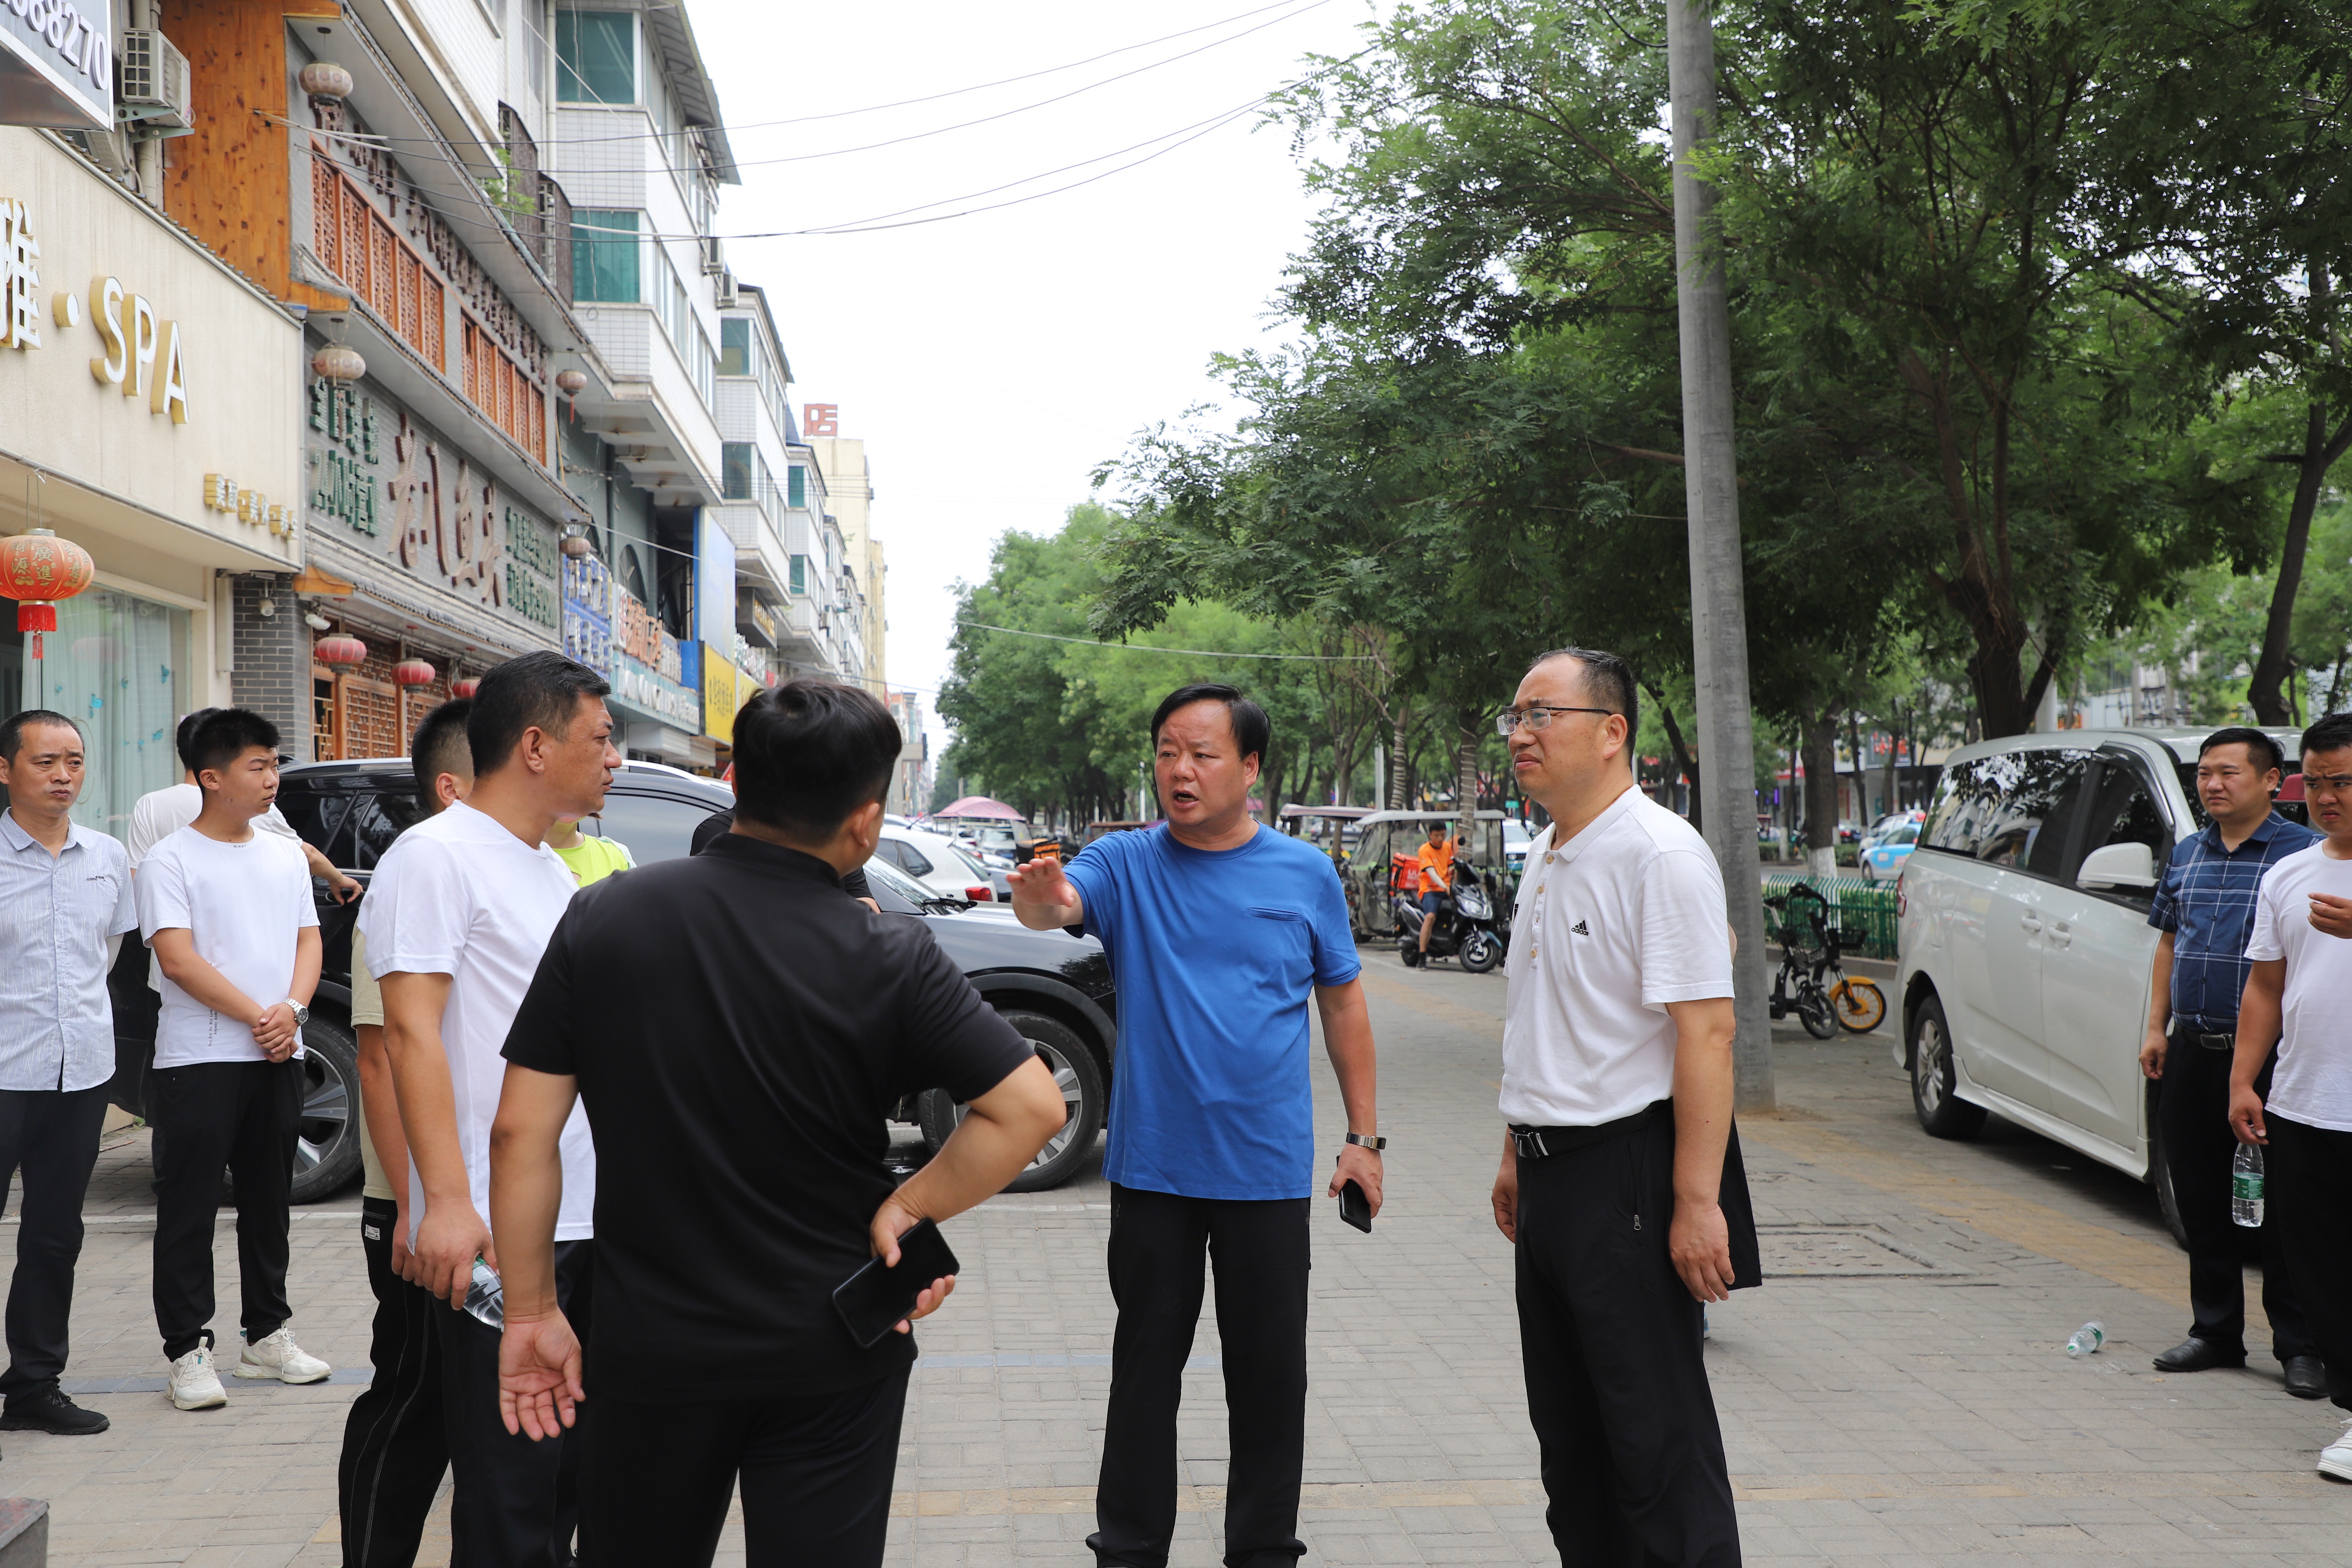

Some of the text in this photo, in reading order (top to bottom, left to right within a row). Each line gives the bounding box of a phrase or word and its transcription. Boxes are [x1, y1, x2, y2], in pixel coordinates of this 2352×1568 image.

[0, 0, 109, 90] 8270
[804, 403, 838, 436] 店
[1571, 927, 1589, 936] adidas
